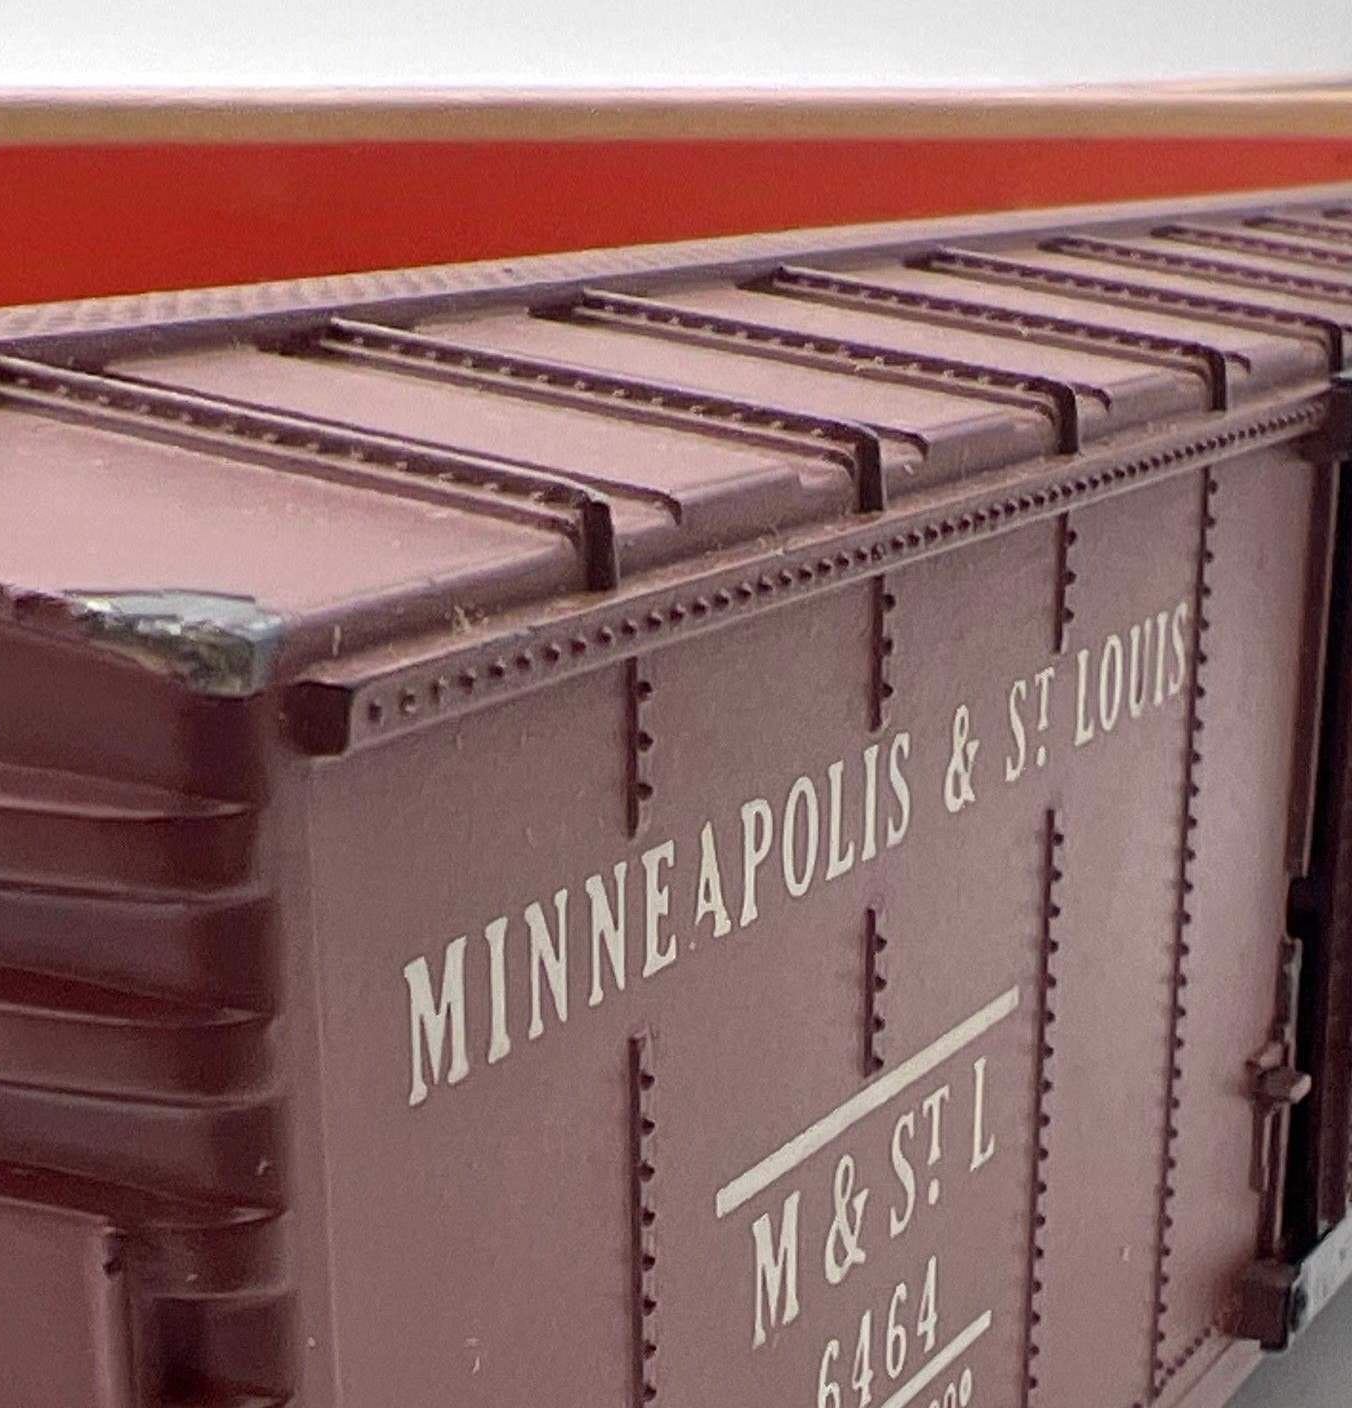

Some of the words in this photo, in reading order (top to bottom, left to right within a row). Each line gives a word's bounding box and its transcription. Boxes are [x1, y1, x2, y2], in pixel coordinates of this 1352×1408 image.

[403, 731, 913, 1107] MINNEAPOLIS
[943, 704, 976, 812] &
[1073, 601, 1190, 747] LOUIS
[752, 1190, 800, 1349] M
[824, 1153, 870, 1286] &
[969, 1056, 995, 1173] L
